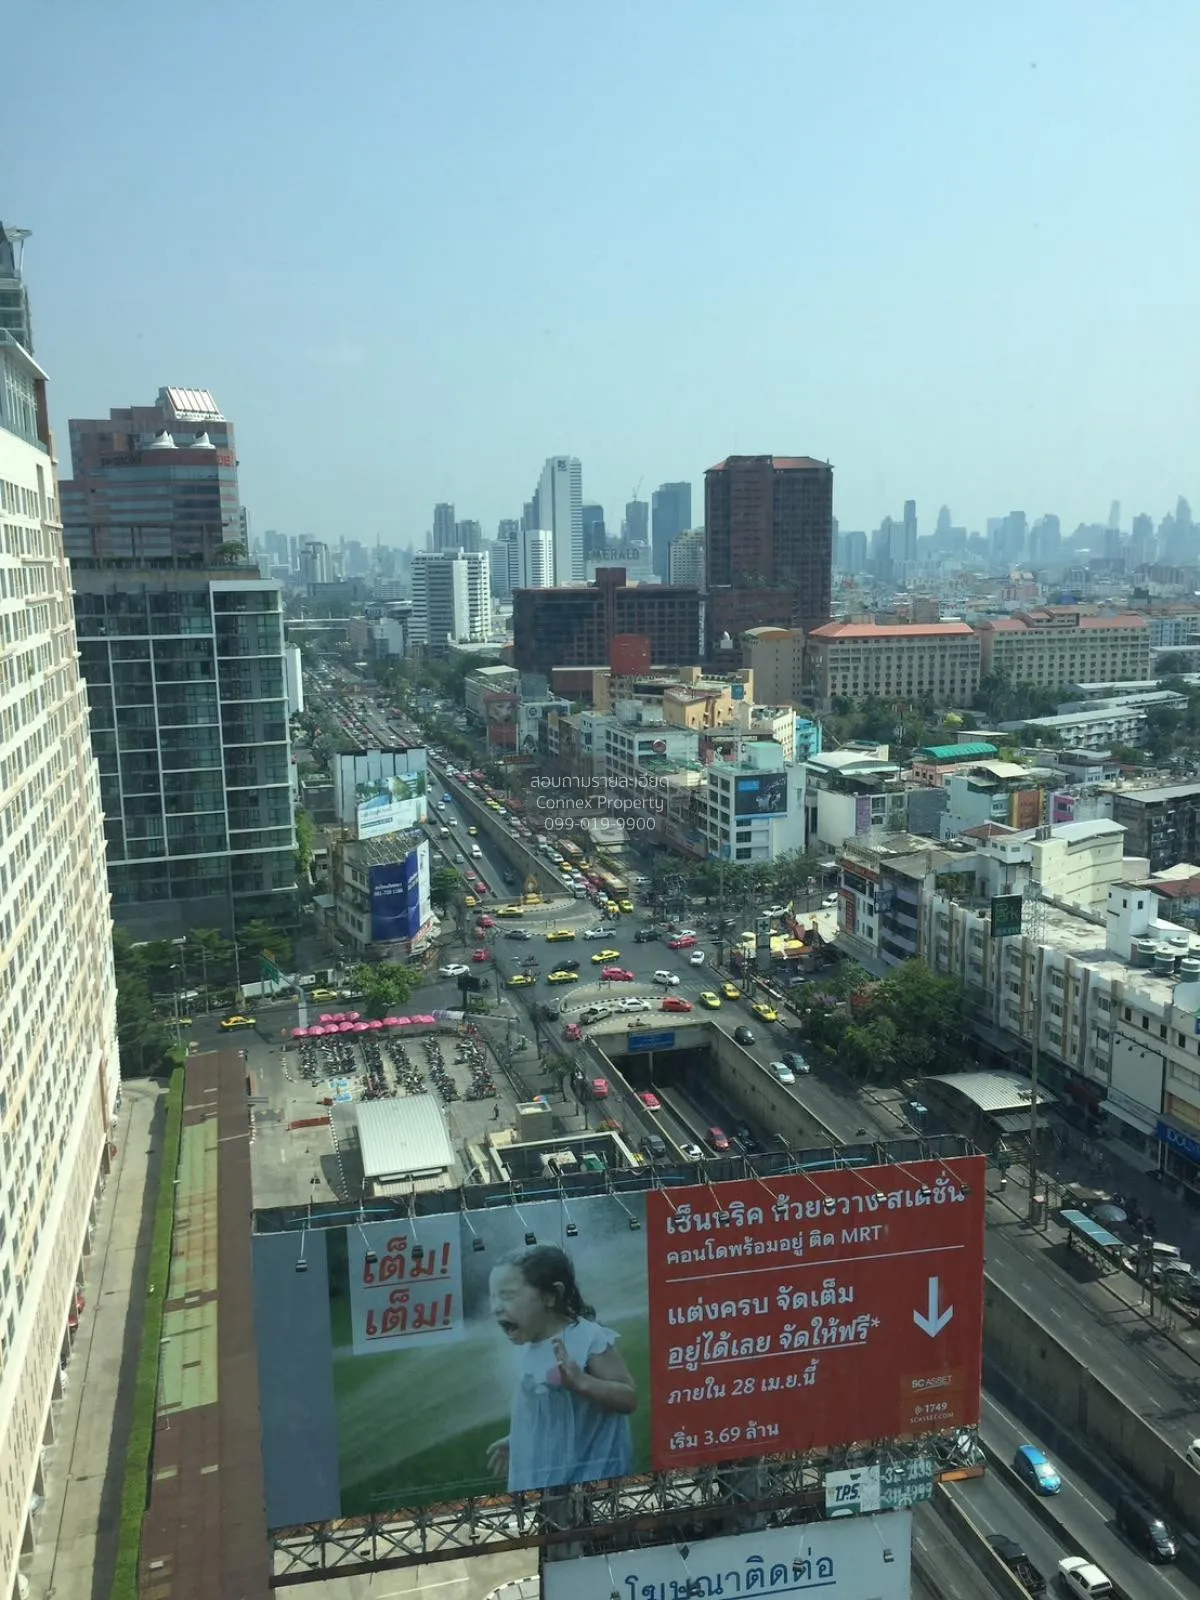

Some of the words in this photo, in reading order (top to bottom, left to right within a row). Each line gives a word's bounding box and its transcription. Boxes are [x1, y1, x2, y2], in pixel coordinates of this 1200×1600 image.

[363, 1235, 450, 1284] เต็ม!
[667, 1231, 803, 1264] คอนโดพร้อมอยู่
[809, 1229, 835, 1248] ติด
[366, 1288, 452, 1336] เต็ม!
[668, 1297, 769, 1325] แต่งครบ
[776, 1278, 854, 1311] จัดเต็ม
[668, 1331, 771, 1371] อยู่ได้เลย
[667, 1376, 726, 1404] ภายใน
[731, 1377, 756, 1396] 28
[670, 1425, 698, 1450] เริ่ม
[704, 1426, 741, 1445] 3.69
[746, 1420, 779, 1441] ล้าน
